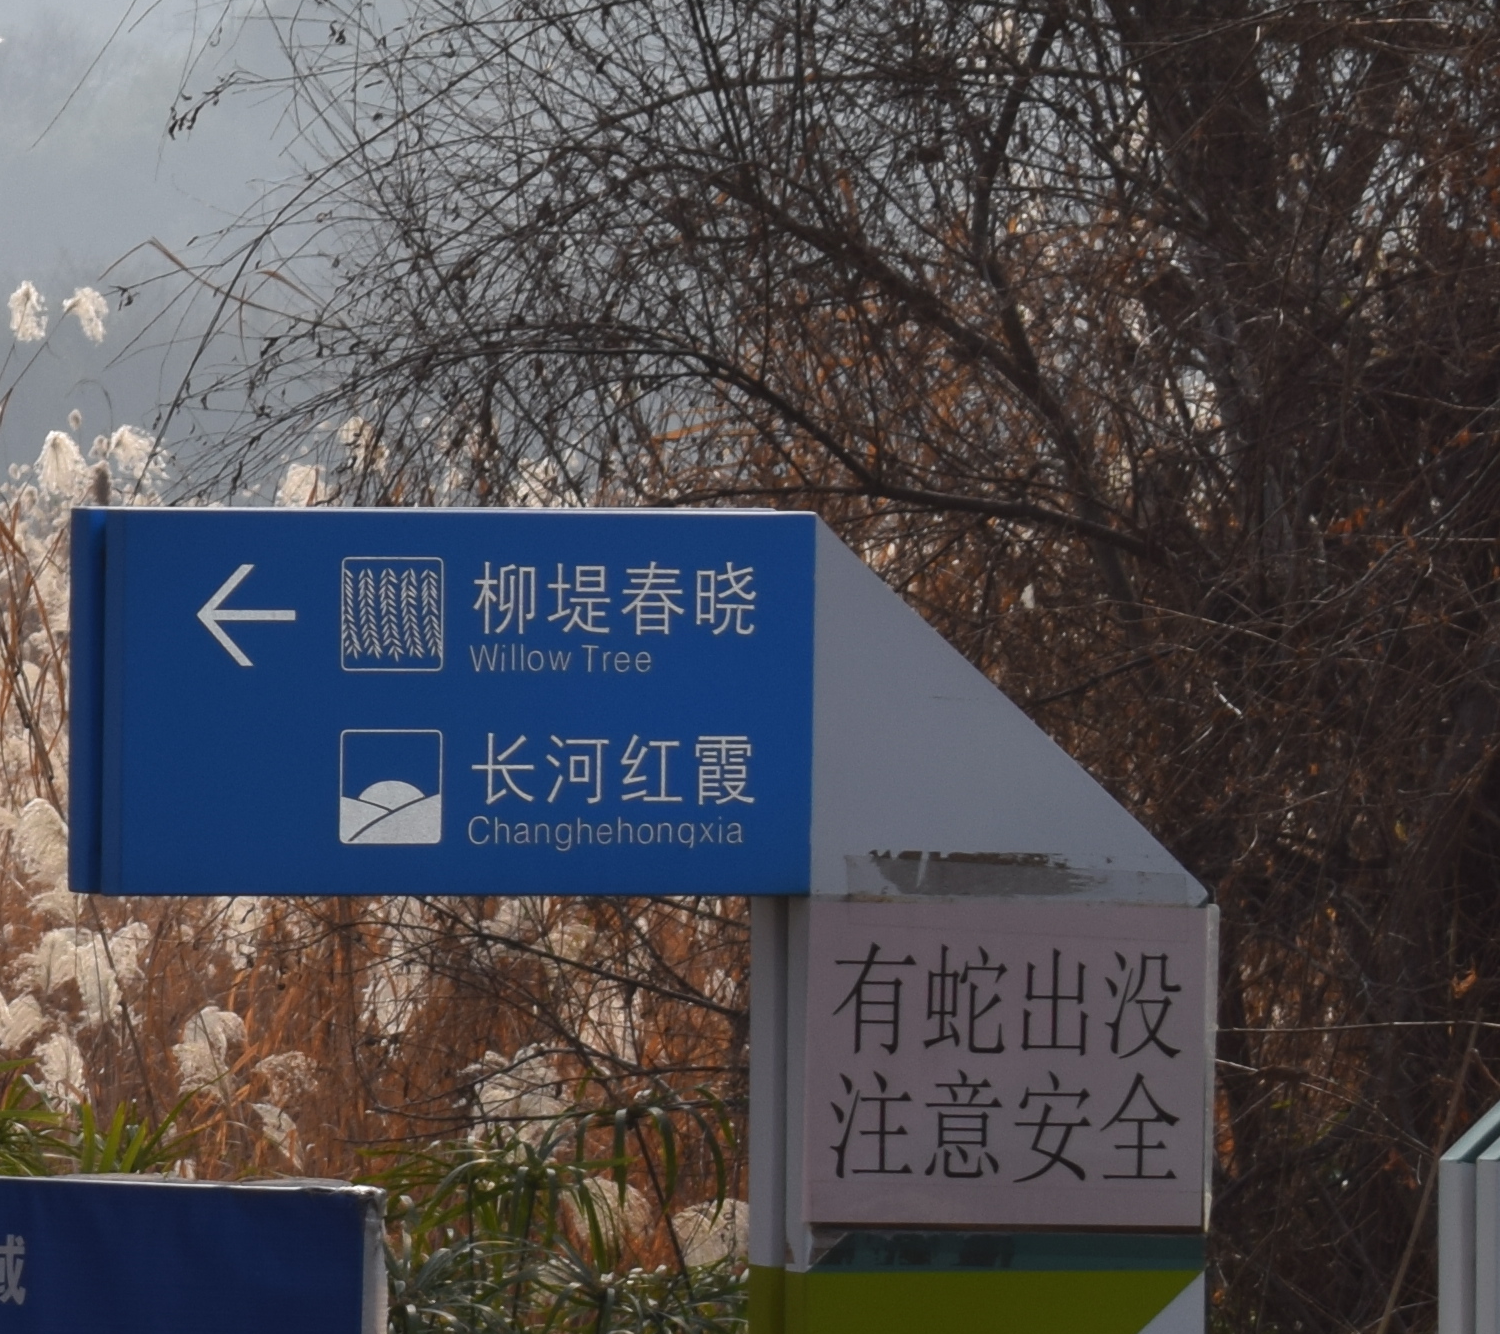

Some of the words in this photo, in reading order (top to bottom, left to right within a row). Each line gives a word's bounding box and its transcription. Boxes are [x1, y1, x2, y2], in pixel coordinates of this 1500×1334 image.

[472, 560, 757, 637] 柳堤春晓
[469, 643, 572, 673] Willow
[581, 644, 652, 673] Tree
[471, 732, 756, 806] 长河红霞
[832, 942, 1182, 1060] 有蛇出没
[829, 1069, 1181, 1184] 注意安全
